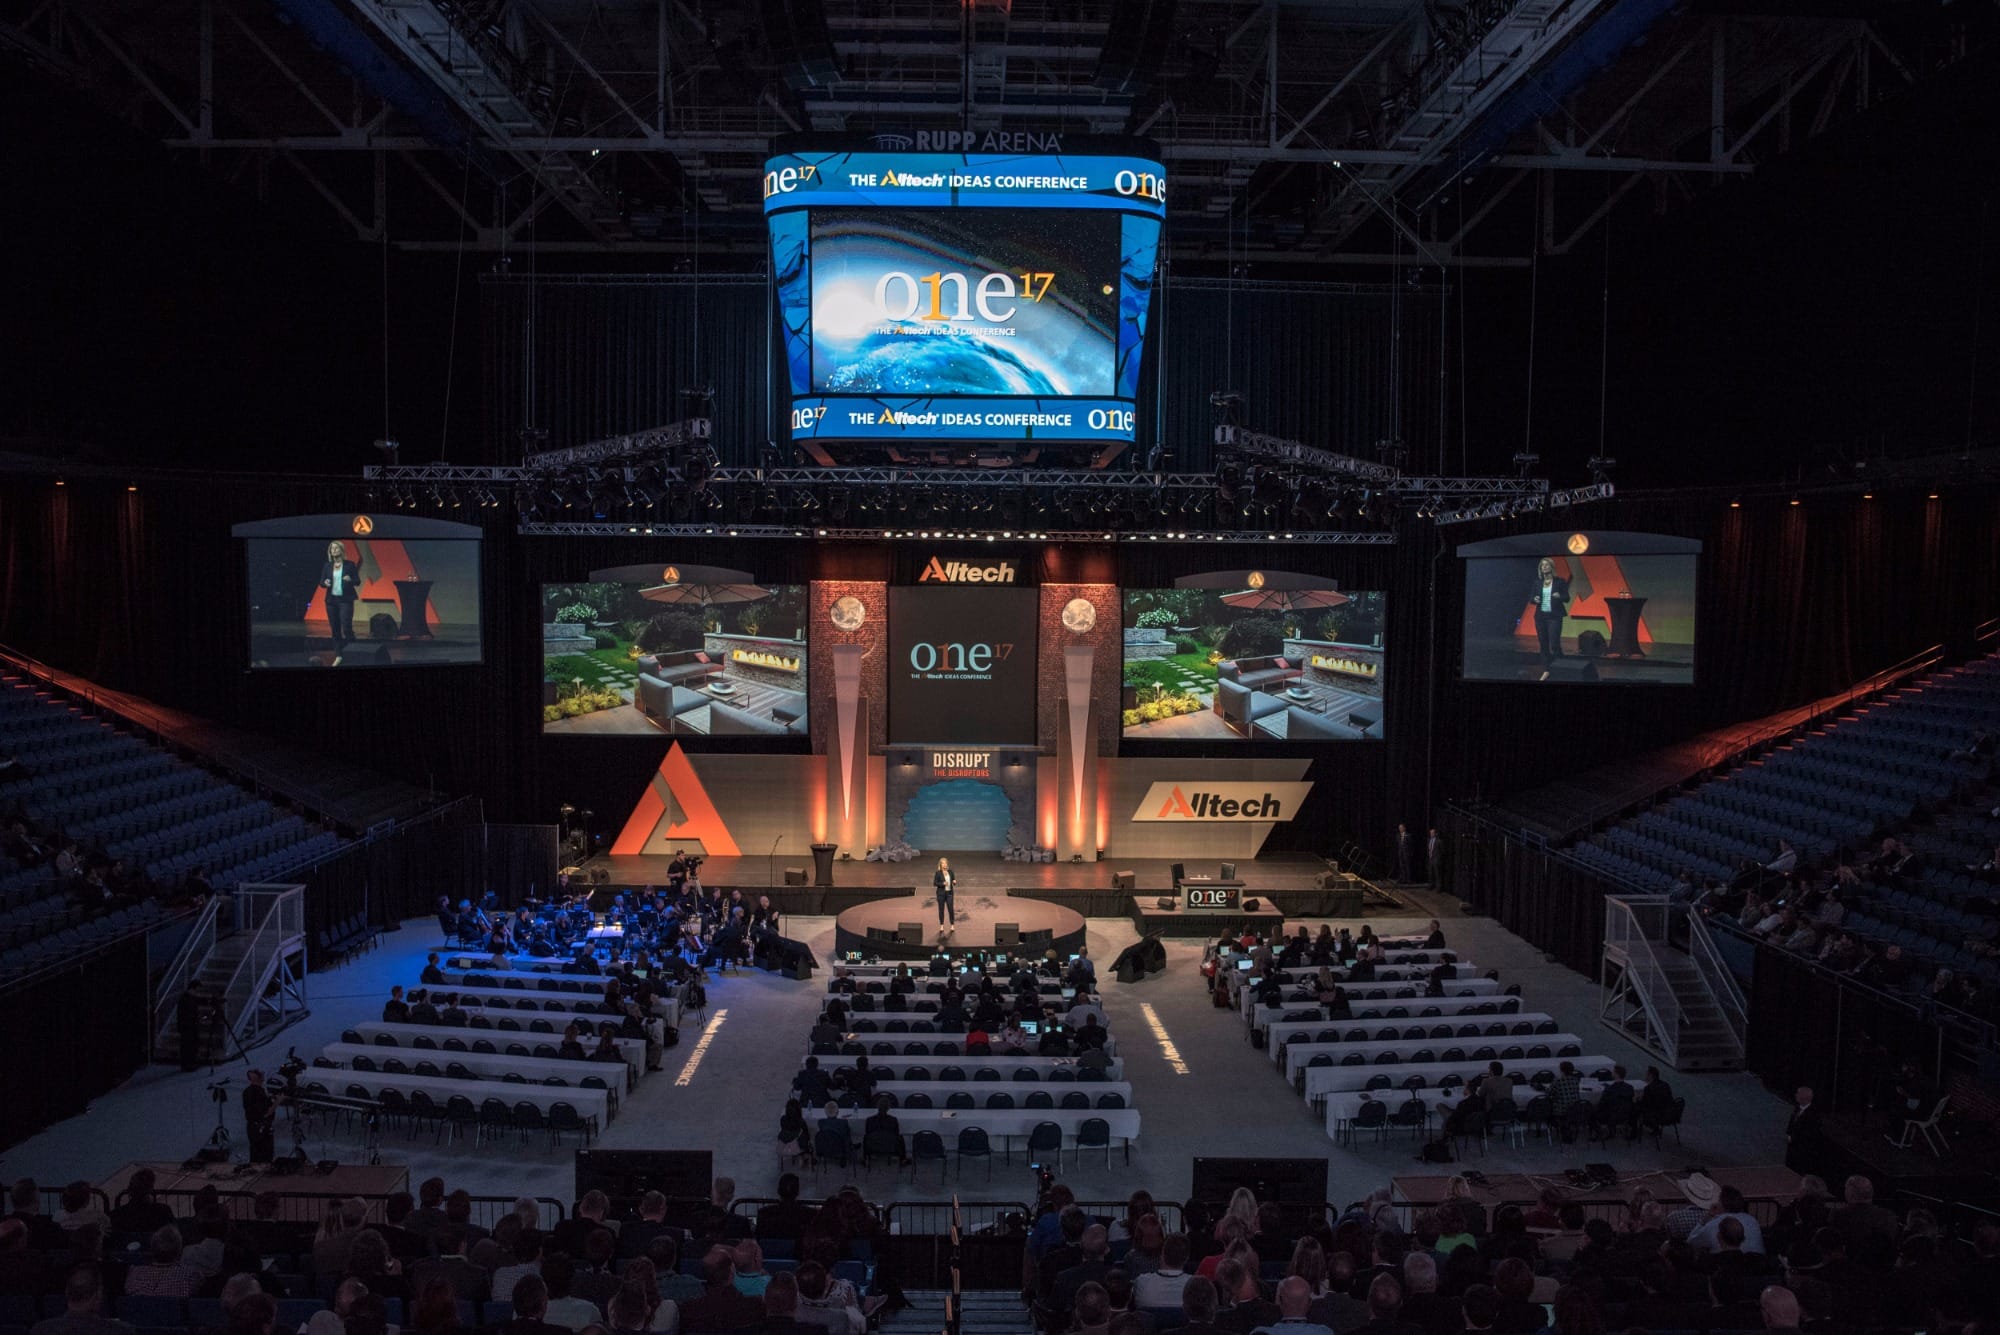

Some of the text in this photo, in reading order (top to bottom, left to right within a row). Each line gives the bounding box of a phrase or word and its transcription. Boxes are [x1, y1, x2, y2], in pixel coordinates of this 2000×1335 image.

[917, 131, 1062, 151] RUPP ARENA
[849, 169, 1087, 189] THE Alltech IDEAS CONFERENCE
[876, 327, 892, 335] THE
[933, 327, 959, 336] IDEAS
[960, 327, 1016, 336] CONFERENCE
[849, 407, 1072, 426] THE Alltech IDEAS CONFERENCE
[919, 556, 1015, 582] Alltech
[933, 753, 990, 768] DISRUPT
[1157, 785, 1281, 817] Alltech
